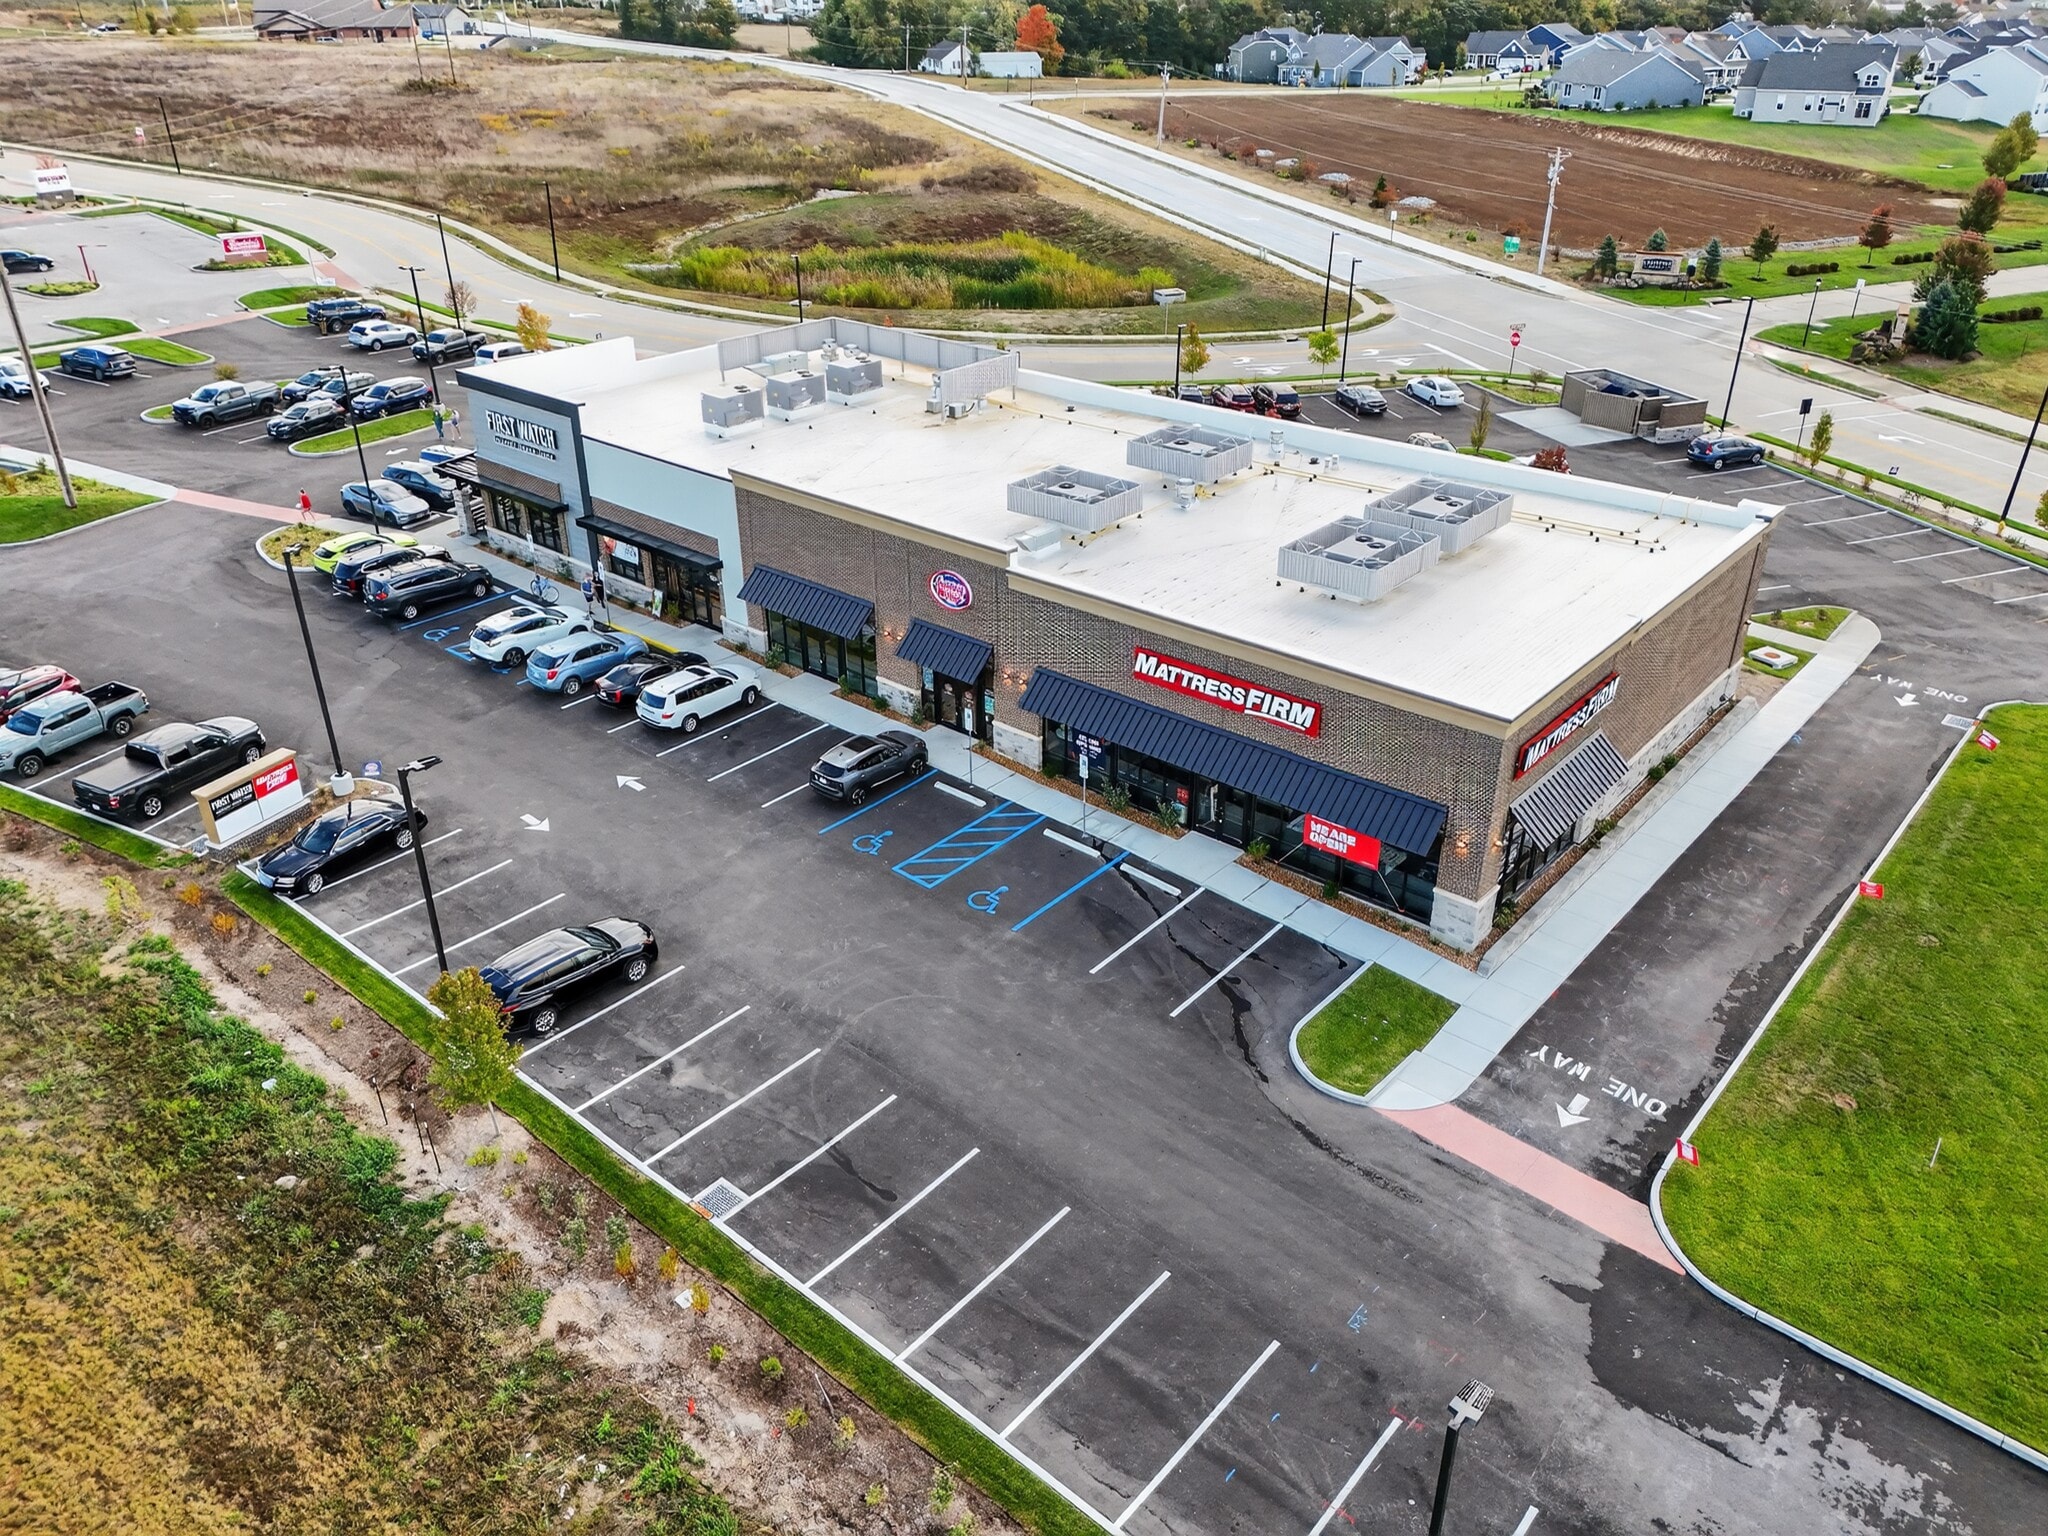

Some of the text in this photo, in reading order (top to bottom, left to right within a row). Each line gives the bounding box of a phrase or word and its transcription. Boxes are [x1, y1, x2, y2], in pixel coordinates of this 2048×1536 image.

[485, 410, 516, 438] FIRST
[516, 418, 557, 450] WATCH
[1869, 674, 1969, 703] ONE WAY
[1309, 831, 1348, 854] OPEN
[1310, 820, 1356, 847] WE ARE
[1526, 1044, 1667, 1118] ONE WAY
